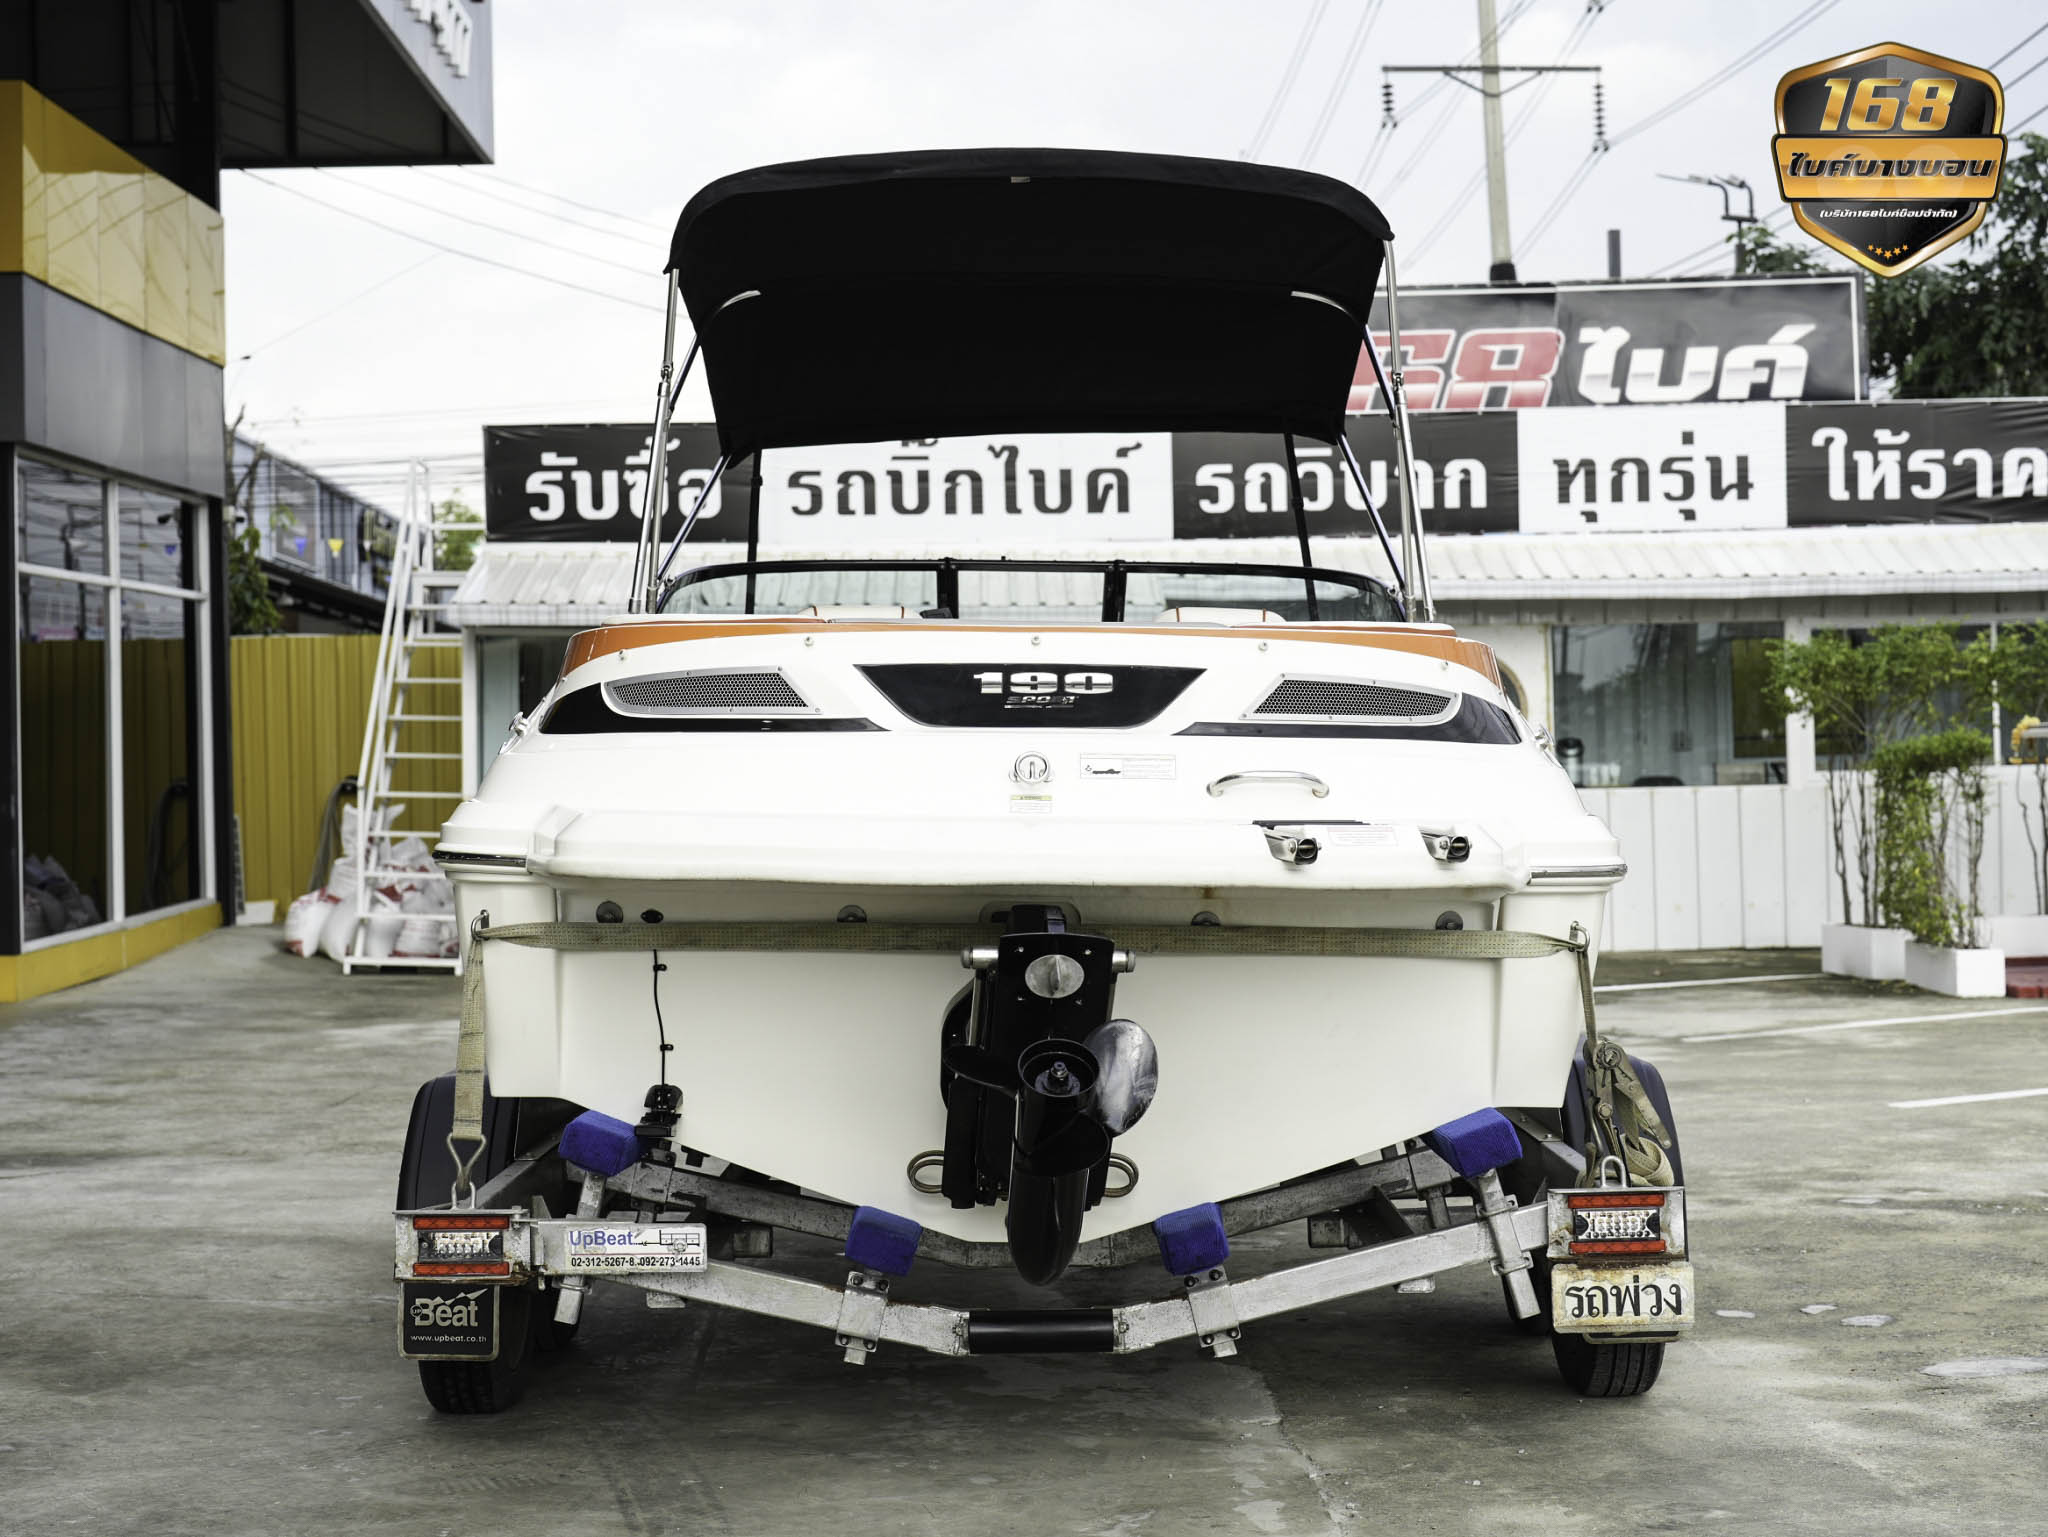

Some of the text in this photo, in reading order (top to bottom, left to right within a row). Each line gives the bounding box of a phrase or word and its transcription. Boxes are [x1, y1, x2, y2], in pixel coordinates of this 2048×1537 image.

[1578, 323, 1817, 404] ไบค์
[1553, 431, 1754, 523] ทุกรุ่น
[973, 672, 1114, 695] 190
[569, 1230, 634, 1249] UpBeat
[414, 1296, 479, 1327] Beat
[1565, 1274, 1682, 1318] รถพ่วง
